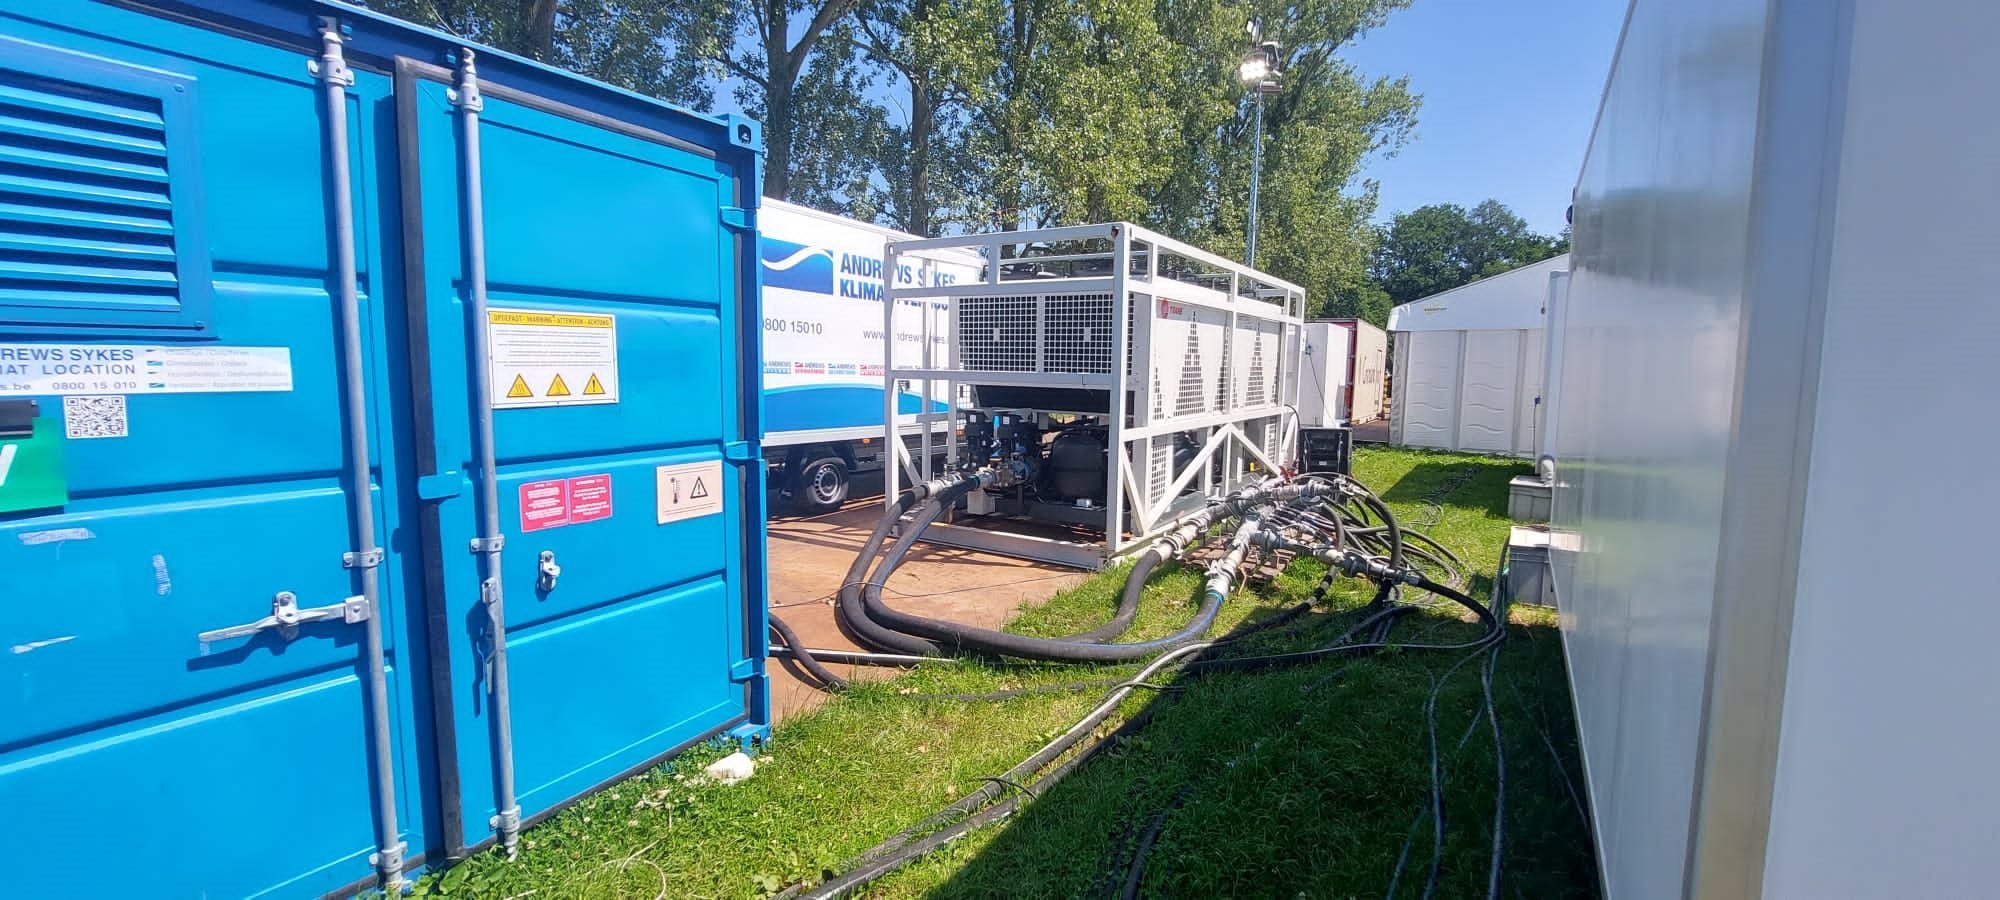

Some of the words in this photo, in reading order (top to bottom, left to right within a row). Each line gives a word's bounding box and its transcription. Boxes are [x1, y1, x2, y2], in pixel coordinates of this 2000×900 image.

[840, 252, 912, 285] ANDRS
[918, 267, 956, 288] SKES
[763, 318, 786, 331] 800
[790, 320, 823, 335] 15010
[70, 349, 134, 361] SYKES
[0, 364, 29, 375] AT
[42, 364, 136, 375] LOCATION
[52, 382, 86, 391] 0800
[93, 382, 108, 390] 15
[113, 381, 137, 390] 010
